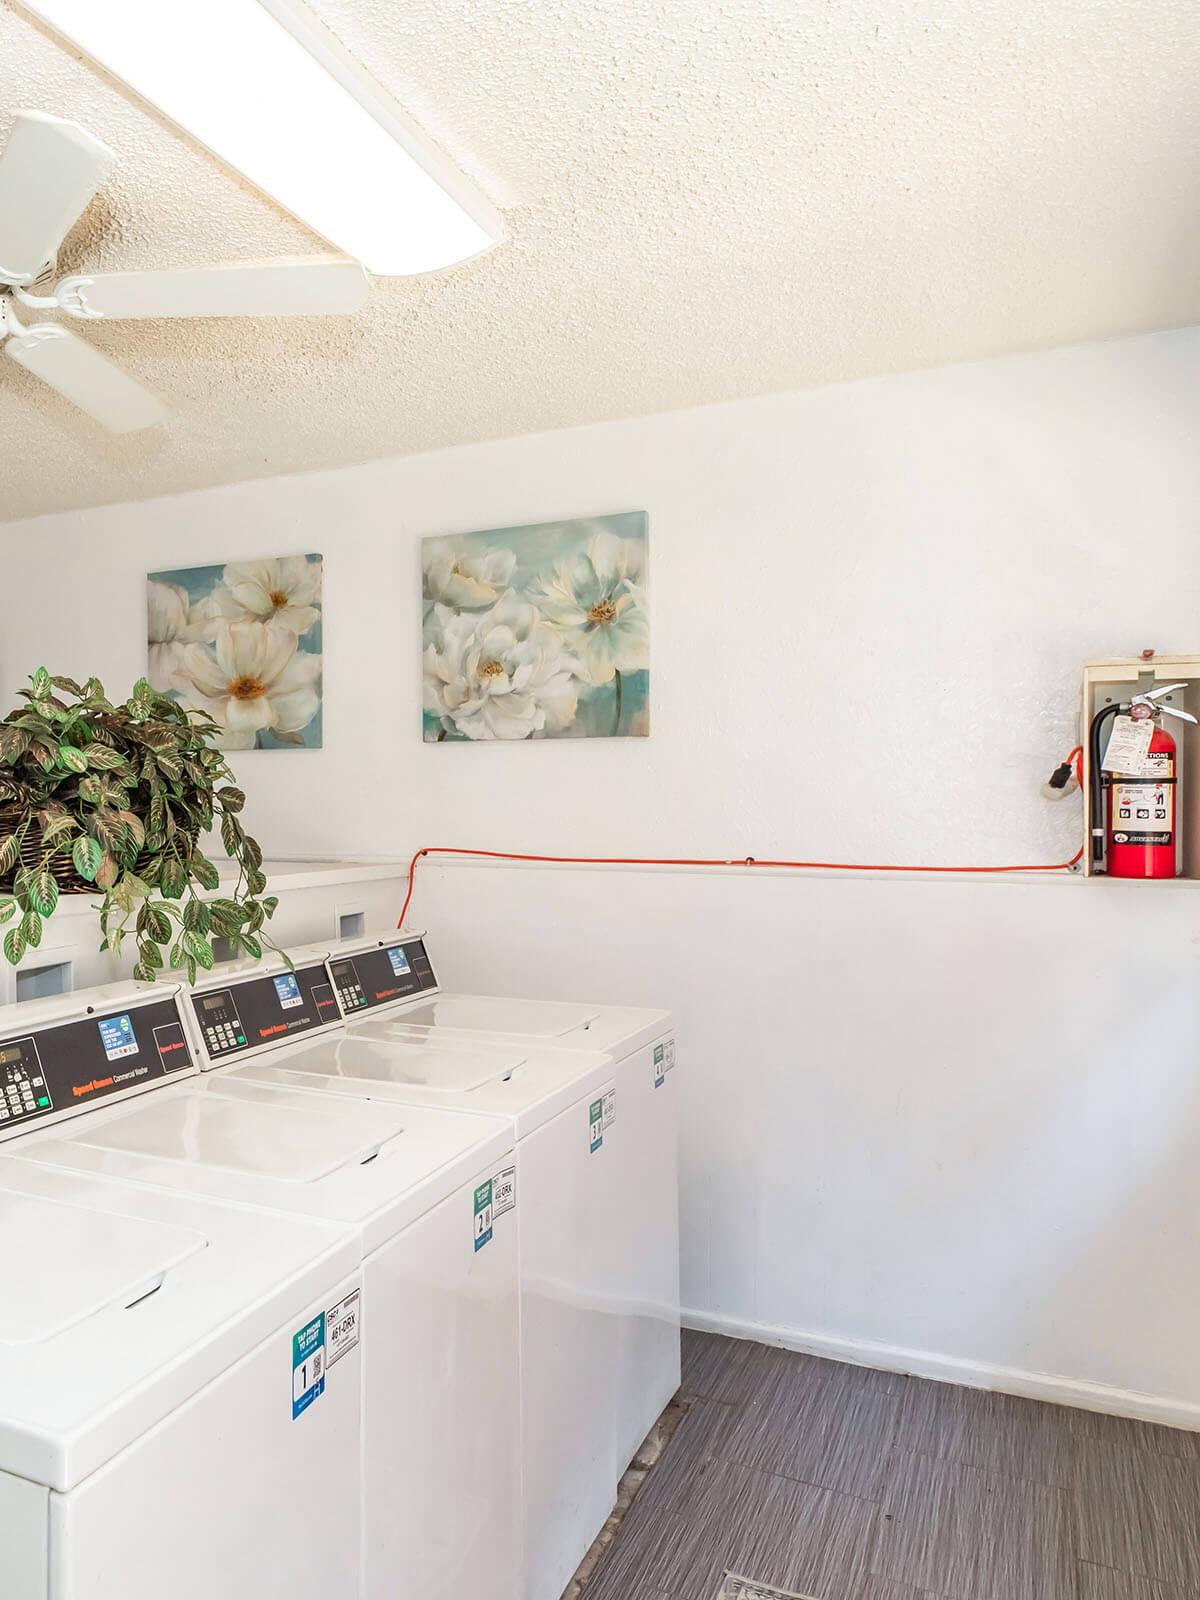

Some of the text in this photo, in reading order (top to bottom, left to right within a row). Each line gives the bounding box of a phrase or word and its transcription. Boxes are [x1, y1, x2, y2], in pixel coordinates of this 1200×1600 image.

[72, 1081, 94, 1097] Speed
[93, 1077, 113, 1089] Queen
[592, 1124, 596, 1139] 3
[479, 1214, 483, 1233] 2
[331, 1313, 356, 1341] 461-DRX
[301, 1364, 306, 1389] 1
